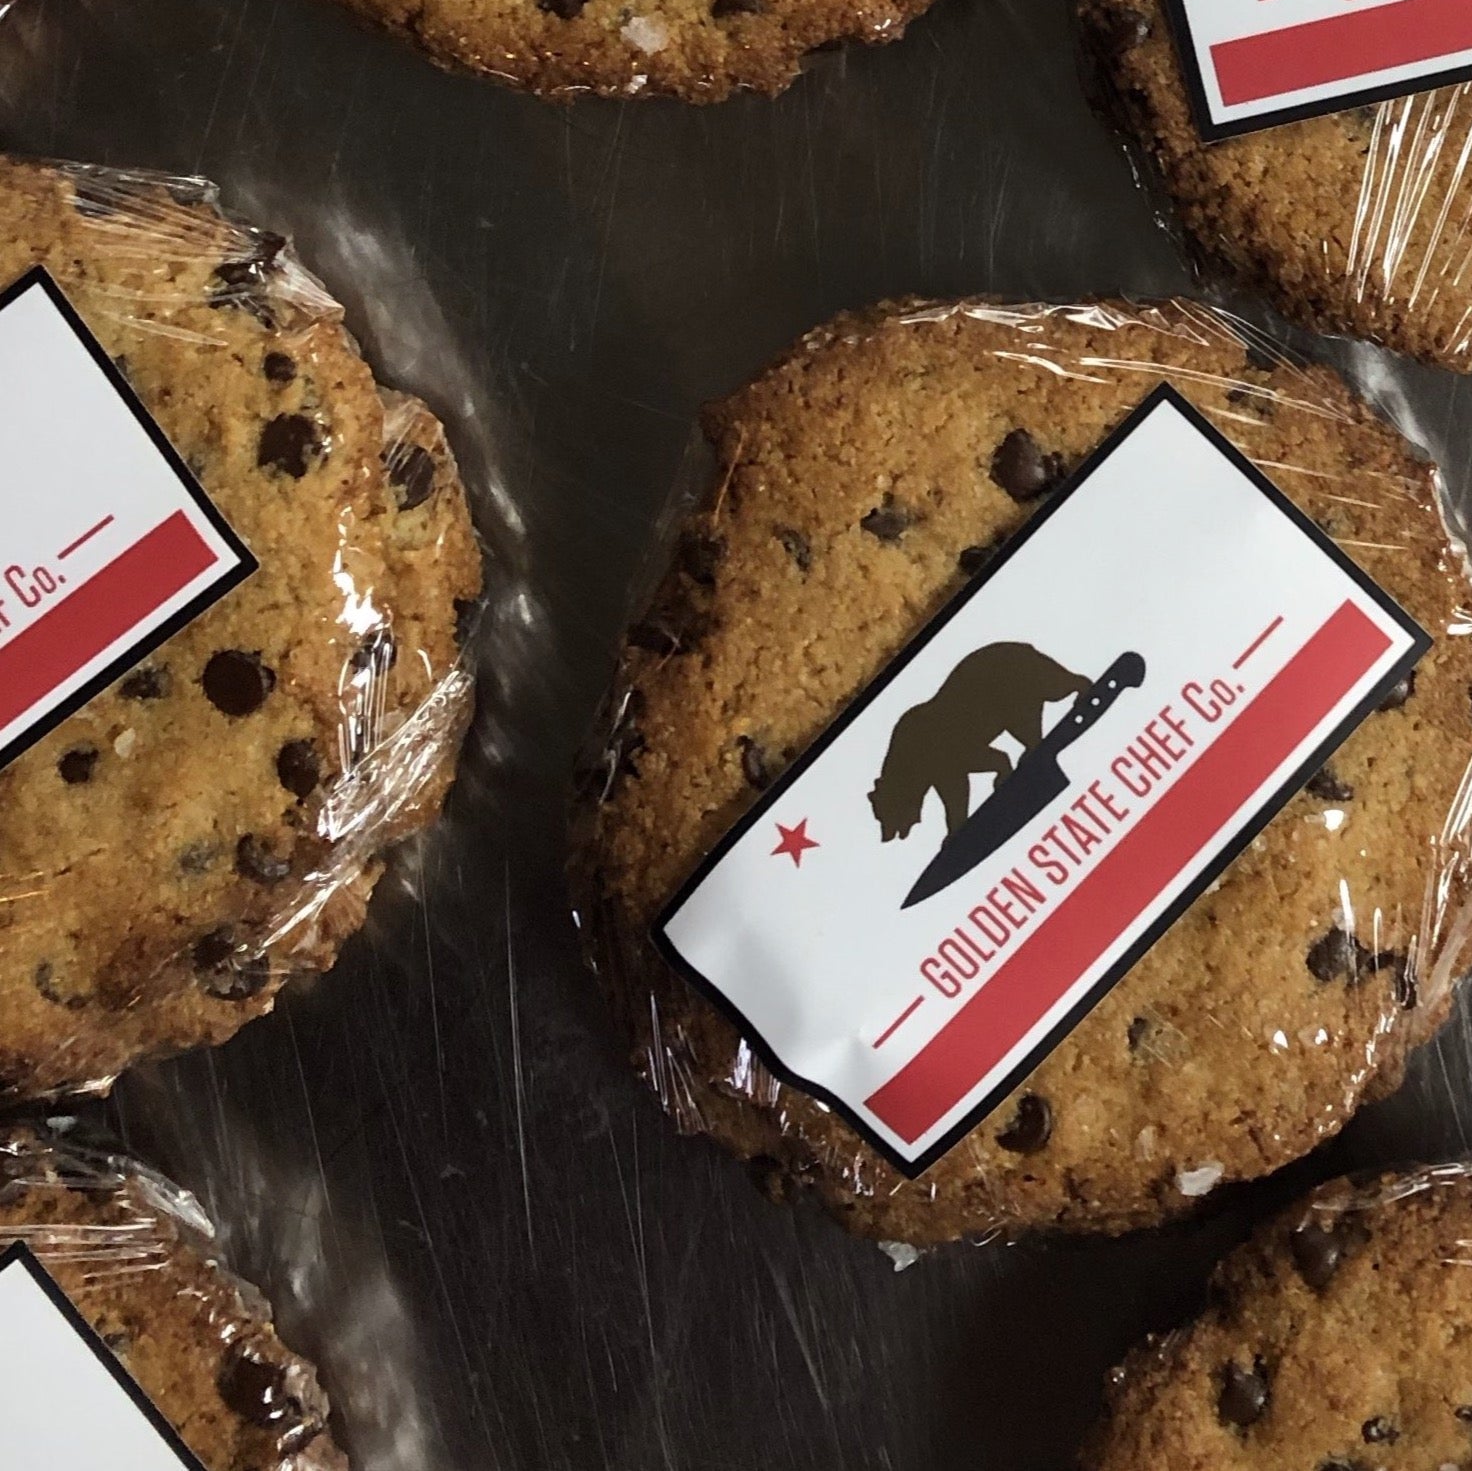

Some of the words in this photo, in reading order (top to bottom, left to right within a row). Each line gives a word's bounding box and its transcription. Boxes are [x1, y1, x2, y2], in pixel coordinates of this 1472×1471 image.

[920, 868, 1047, 999] GOLDEN
[1027, 779, 1130, 886] STATE
[1110, 706, 1195, 798] CHEF
